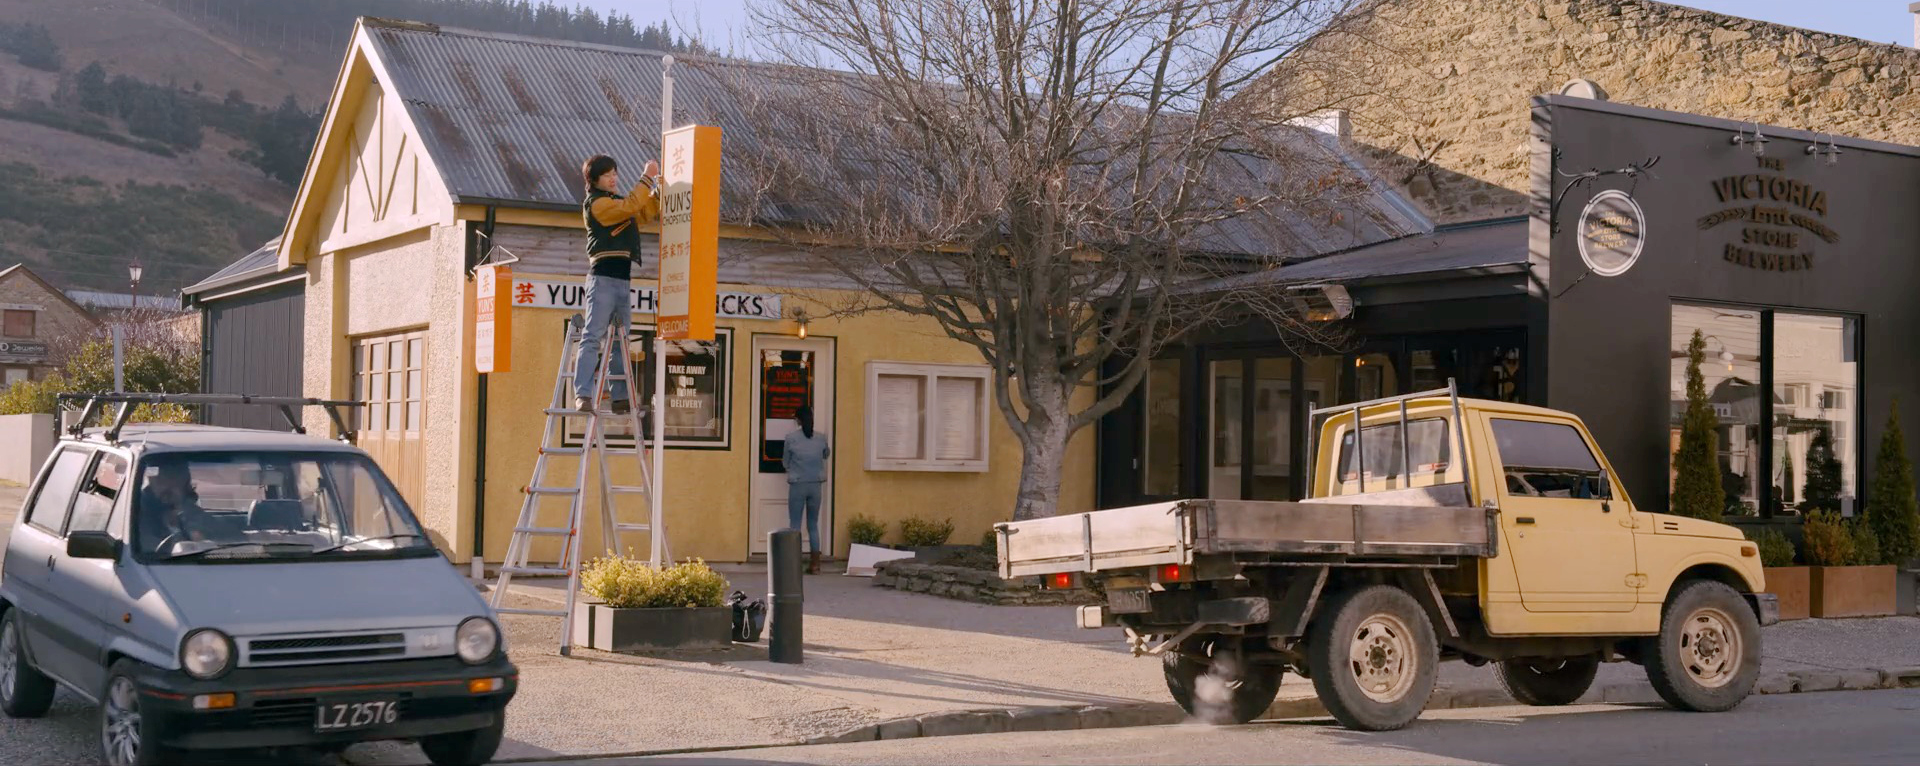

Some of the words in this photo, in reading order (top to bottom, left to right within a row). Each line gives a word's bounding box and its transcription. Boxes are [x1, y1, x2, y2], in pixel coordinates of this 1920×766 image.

[1756, 156, 1785, 171] THE
[664, 190, 692, 214] YUN'S
[1711, 174, 1828, 218] VICTORIA
[662, 212, 692, 226] CHOPSTICKS
[1589, 216, 1633, 230] VICTORIA
[1594, 239, 1628, 248] BREWERY
[1600, 233, 1621, 241] STORE
[1742, 228, 1799, 248] STORE
[1723, 243, 1816, 272] BREWERY
[515, 282, 536, 304] 芸
[660, 319, 689, 334] WELCOME
[668, 364, 685, 375] TAKE
[686, 366, 707, 375] AWAY
[670, 399, 703, 408] DELIVERY
